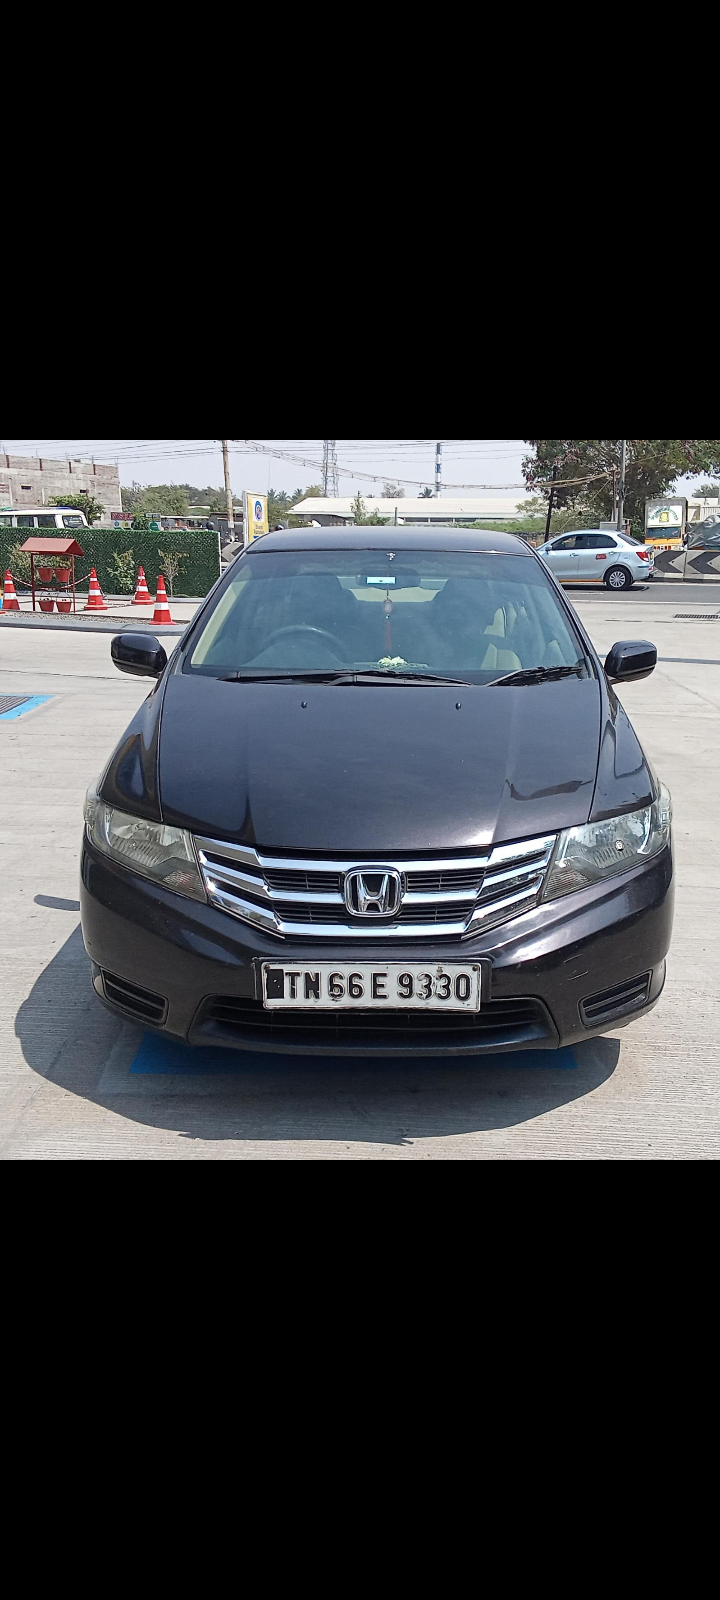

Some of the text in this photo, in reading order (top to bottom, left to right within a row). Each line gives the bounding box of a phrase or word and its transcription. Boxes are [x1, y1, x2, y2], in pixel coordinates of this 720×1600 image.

[285, 971, 472, 1000] TN 66 E 9330
